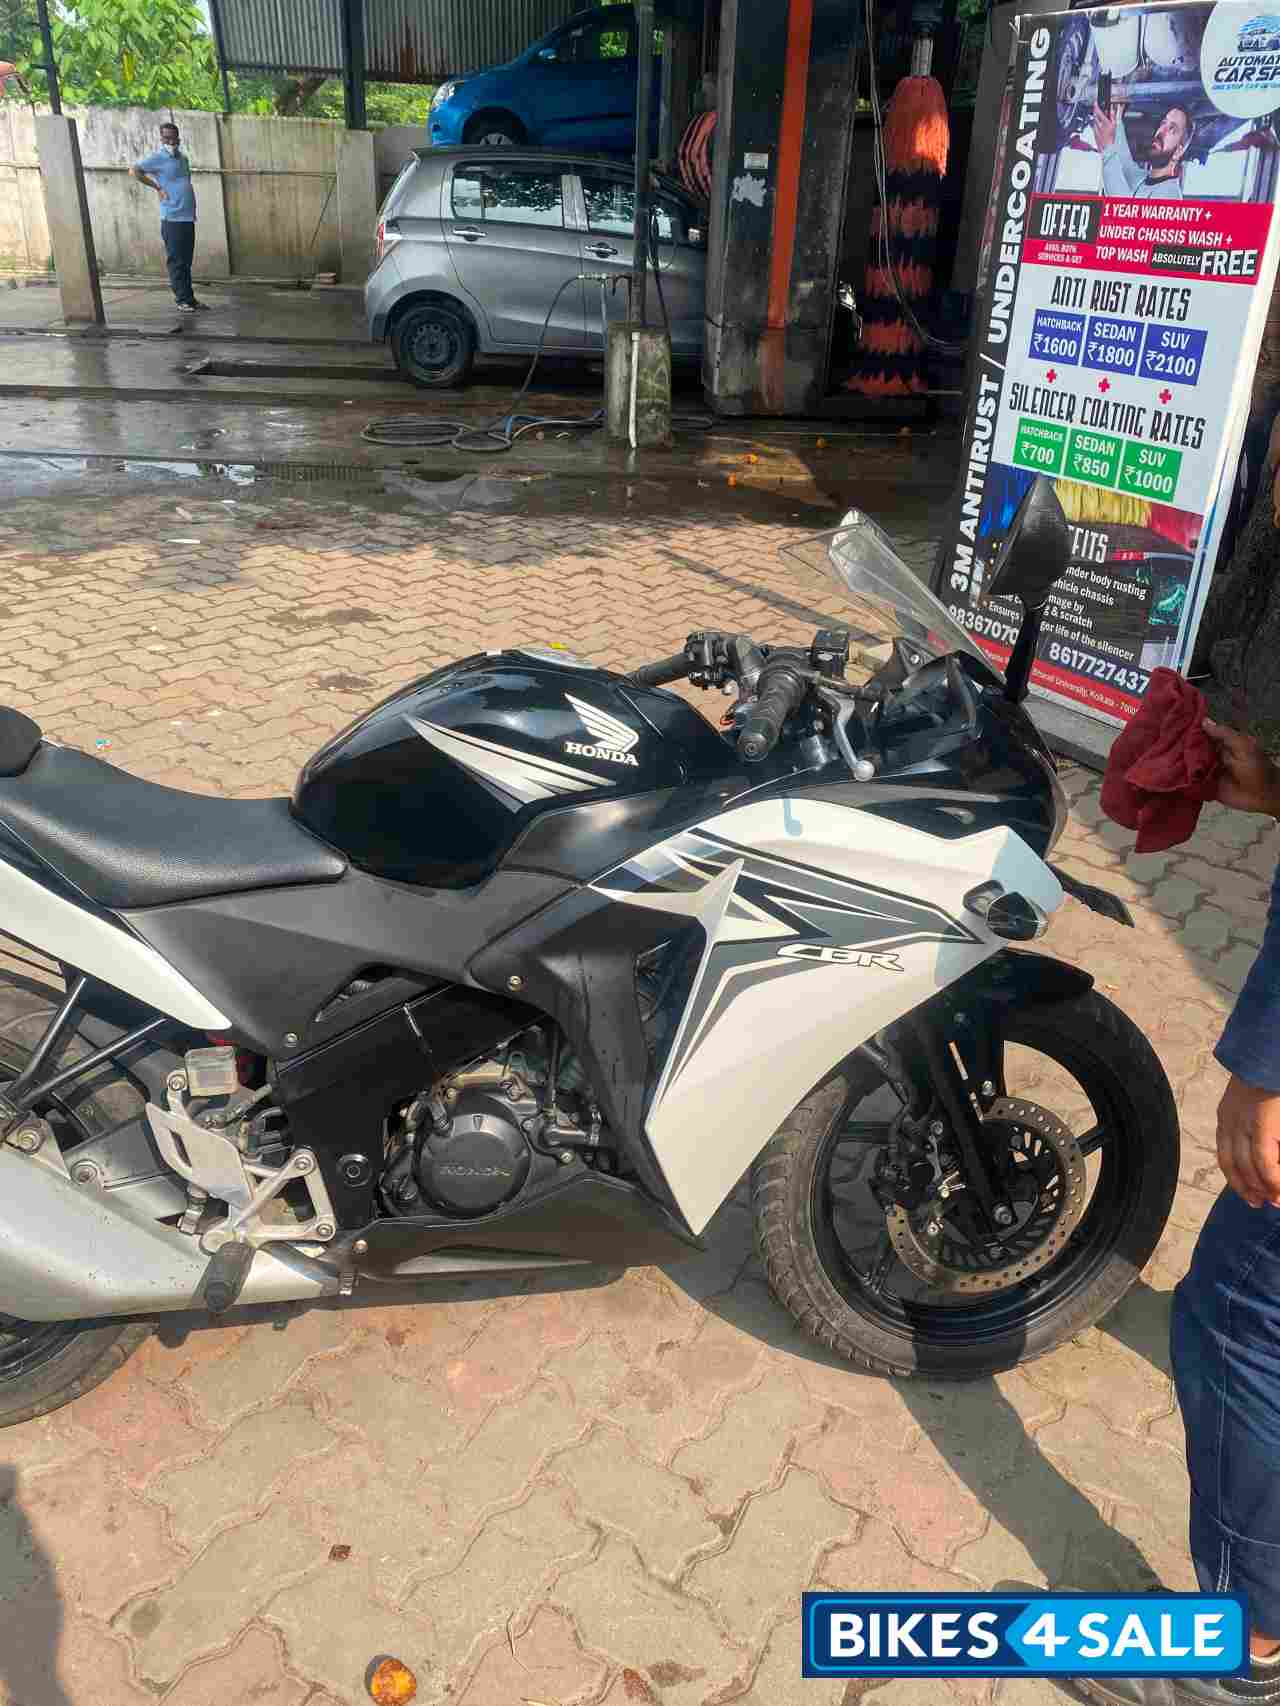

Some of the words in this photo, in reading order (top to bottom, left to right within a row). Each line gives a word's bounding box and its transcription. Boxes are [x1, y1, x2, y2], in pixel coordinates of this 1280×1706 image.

[987, 27, 1050, 345] UNDERCOATING
[1040, 203, 1090, 240] OFFER
[1103, 204, 1109, 217] 1
[1112, 204, 1138, 218] YEAR
[1141, 206, 1203, 222] WARRANTY
[1099, 225, 1135, 241] UNDER
[1137, 227, 1186, 243] CHASSIS
[1188, 230, 1223, 246] WASH
[1096, 246, 1116, 260] TOP
[1117, 248, 1149, 263] WASH
[1152, 252, 1200, 266] ABSOLUTELY
[1200, 249, 1258, 276] FREE
[1050, 275, 1087, 308] ANTI
[1090, 279, 1132, 314] RUST
[1135, 285, 1191, 321] RATES
[1036, 316, 1082, 331] HATCHBACK
[1094, 322, 1136, 342] SEDAN
[1034, 333, 1077, 358] ₹1600
[1161, 331, 1191, 350] SUV
[1087, 341, 1135, 367] ₹1800
[1146, 350, 1196, 377] ₹2100
[1009, 382, 1076, 423] SILENCER
[1080, 396, 1146, 438] COATING
[1150, 410, 1206, 449] RATES
[959, 374, 1000, 541] ANTIRUST
[1021, 442, 1055, 465] ₹700
[1075, 434, 1116, 457] SEDAN
[1139, 449, 1167, 467] SUV
[1073, 454, 1110, 479] ₹850
[1124, 464, 1173, 494] ₹1000
[1068, 527, 1109, 563] FITS
[951, 543, 974, 592] 3M
[1080, 587, 1115, 606] chassis
[1091, 570, 1112, 589] body
[1113, 580, 1147, 601] rusting
[1048, 594, 1073, 610] mage
[1074, 600, 1085, 615] by
[1051, 606, 1059, 617] &
[1060, 610, 1093, 629] scratch
[948, 604, 1019, 645] 98367070
[1049, 642, 1151, 693] 8617727437
[1056, 624, 1069, 637] life
[1071, 631, 1081, 641] of
[1081, 634, 1096, 648] the
[1096, 640, 1136, 662] silencer
[565, 741, 639, 766] HONDA
[776, 943, 904, 972] CBR
